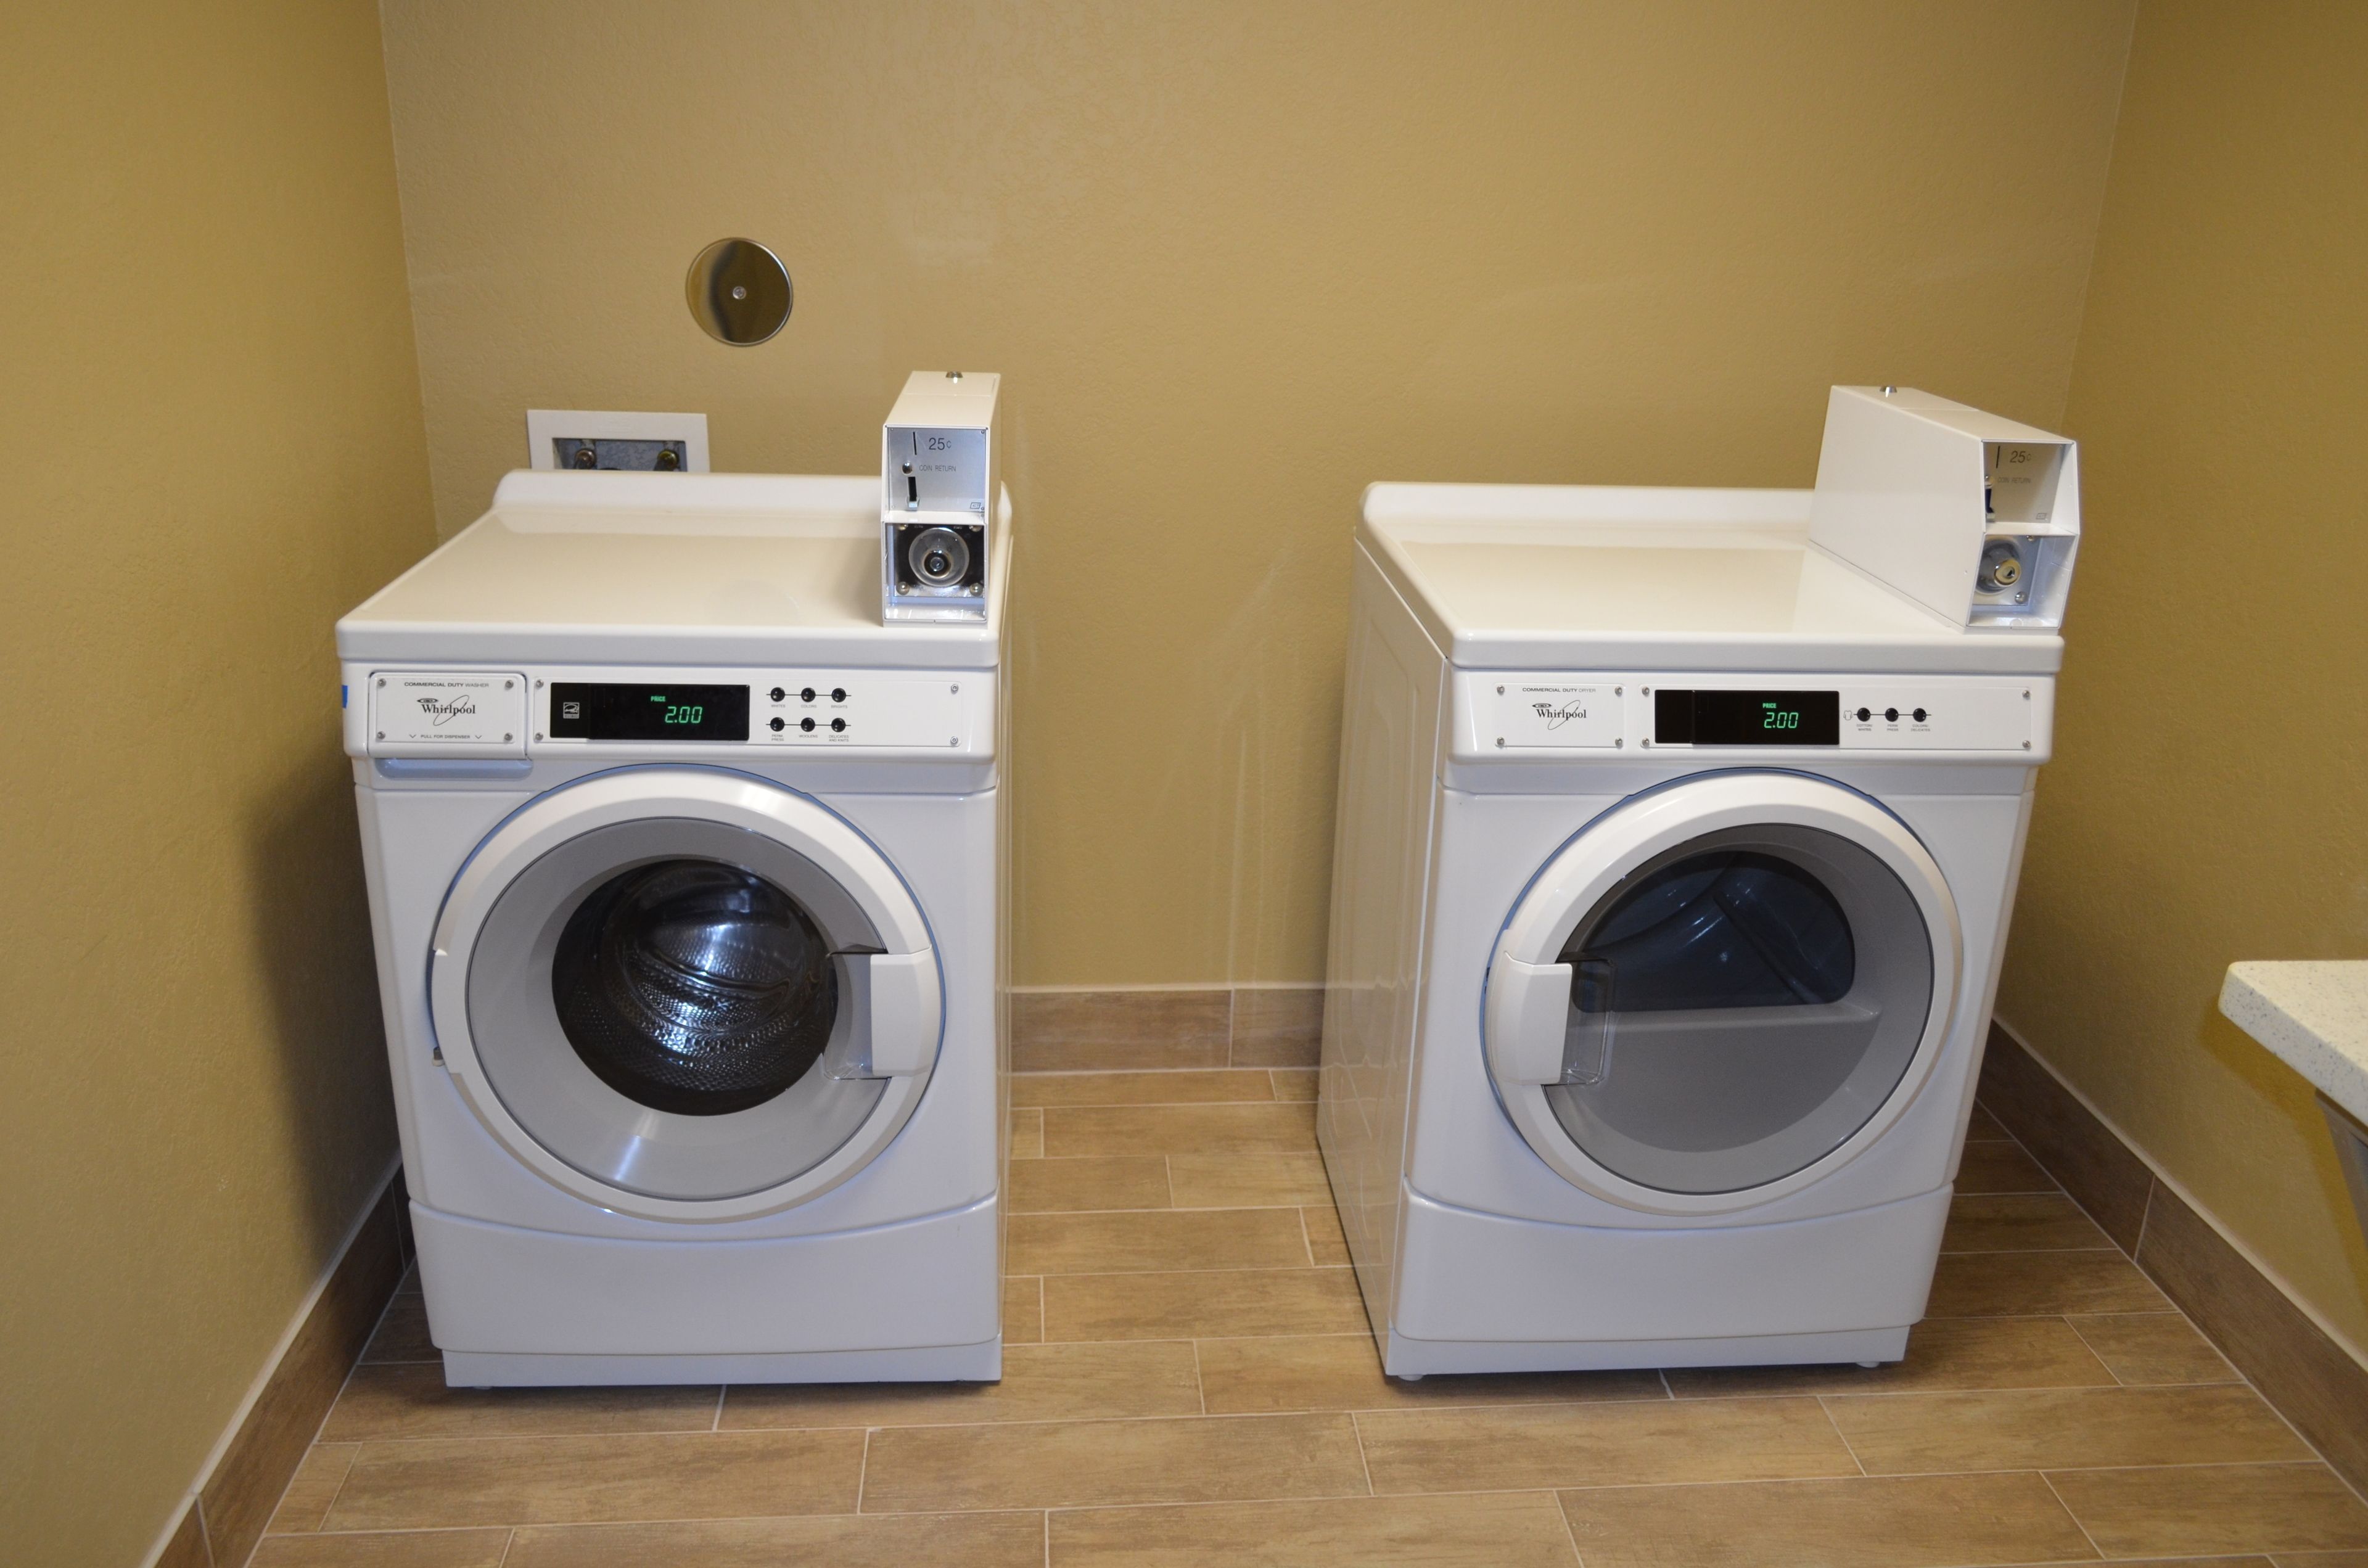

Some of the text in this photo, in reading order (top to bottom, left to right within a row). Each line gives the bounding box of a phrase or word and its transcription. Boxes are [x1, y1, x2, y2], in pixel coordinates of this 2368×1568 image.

[421, 704, 475, 716] Whirlpool
[665, 706, 703, 723] 2.00
[1536, 708, 1587, 721] Whirlpool
[1764, 712, 1799, 728] 2.00
